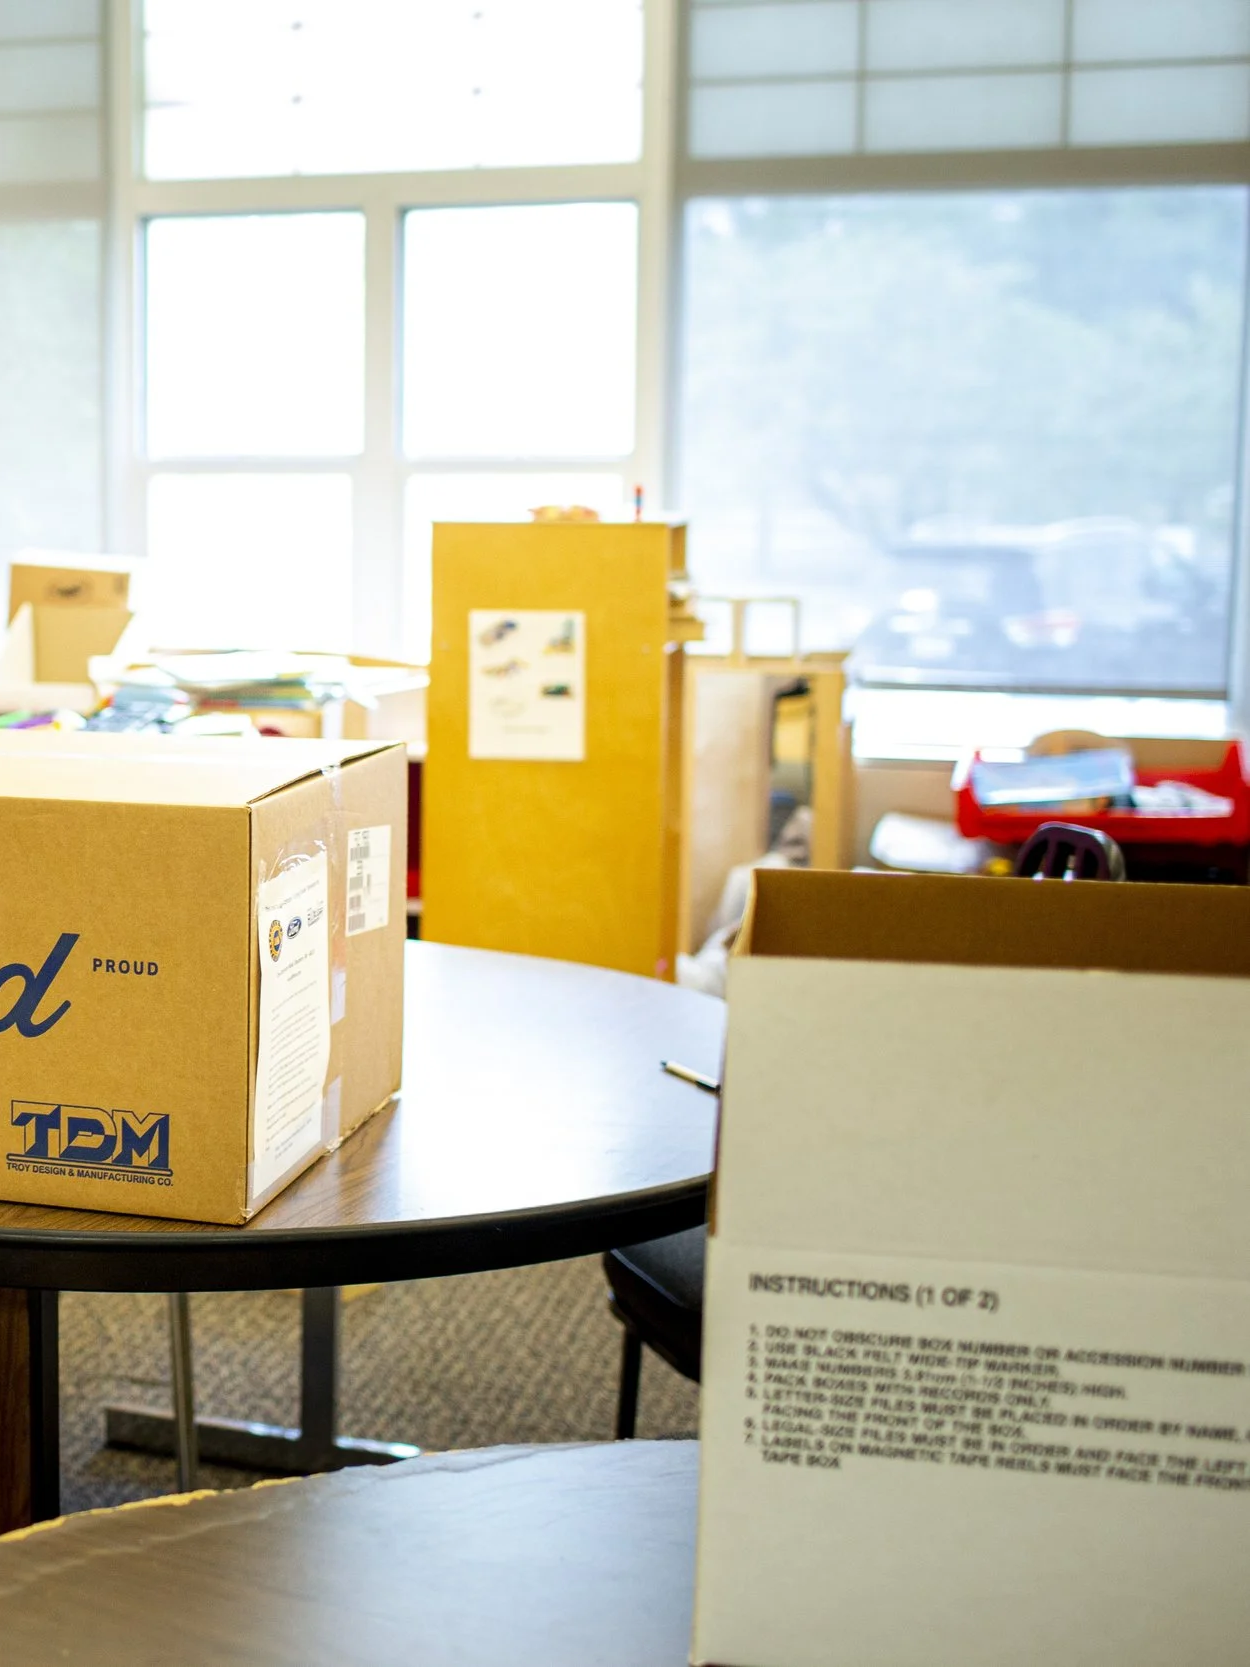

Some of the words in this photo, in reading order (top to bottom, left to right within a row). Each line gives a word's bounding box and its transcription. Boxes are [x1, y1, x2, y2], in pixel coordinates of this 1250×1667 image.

[92, 957, 159, 977] PROUD
[10, 1100, 170, 1169] TDM
[6, 1162, 30, 1173] TROY
[32, 1164, 67, 1177] DESIGN
[68, 1168, 75, 1177] &
[76, 1169, 156, 1185] MANUFACTURING
[157, 1178, 174, 1187] CO.
[748, 1274, 910, 1303] INSTRUCTIONS
[915, 1284, 934, 1308] (1
[941, 1287, 972, 1307] OF
